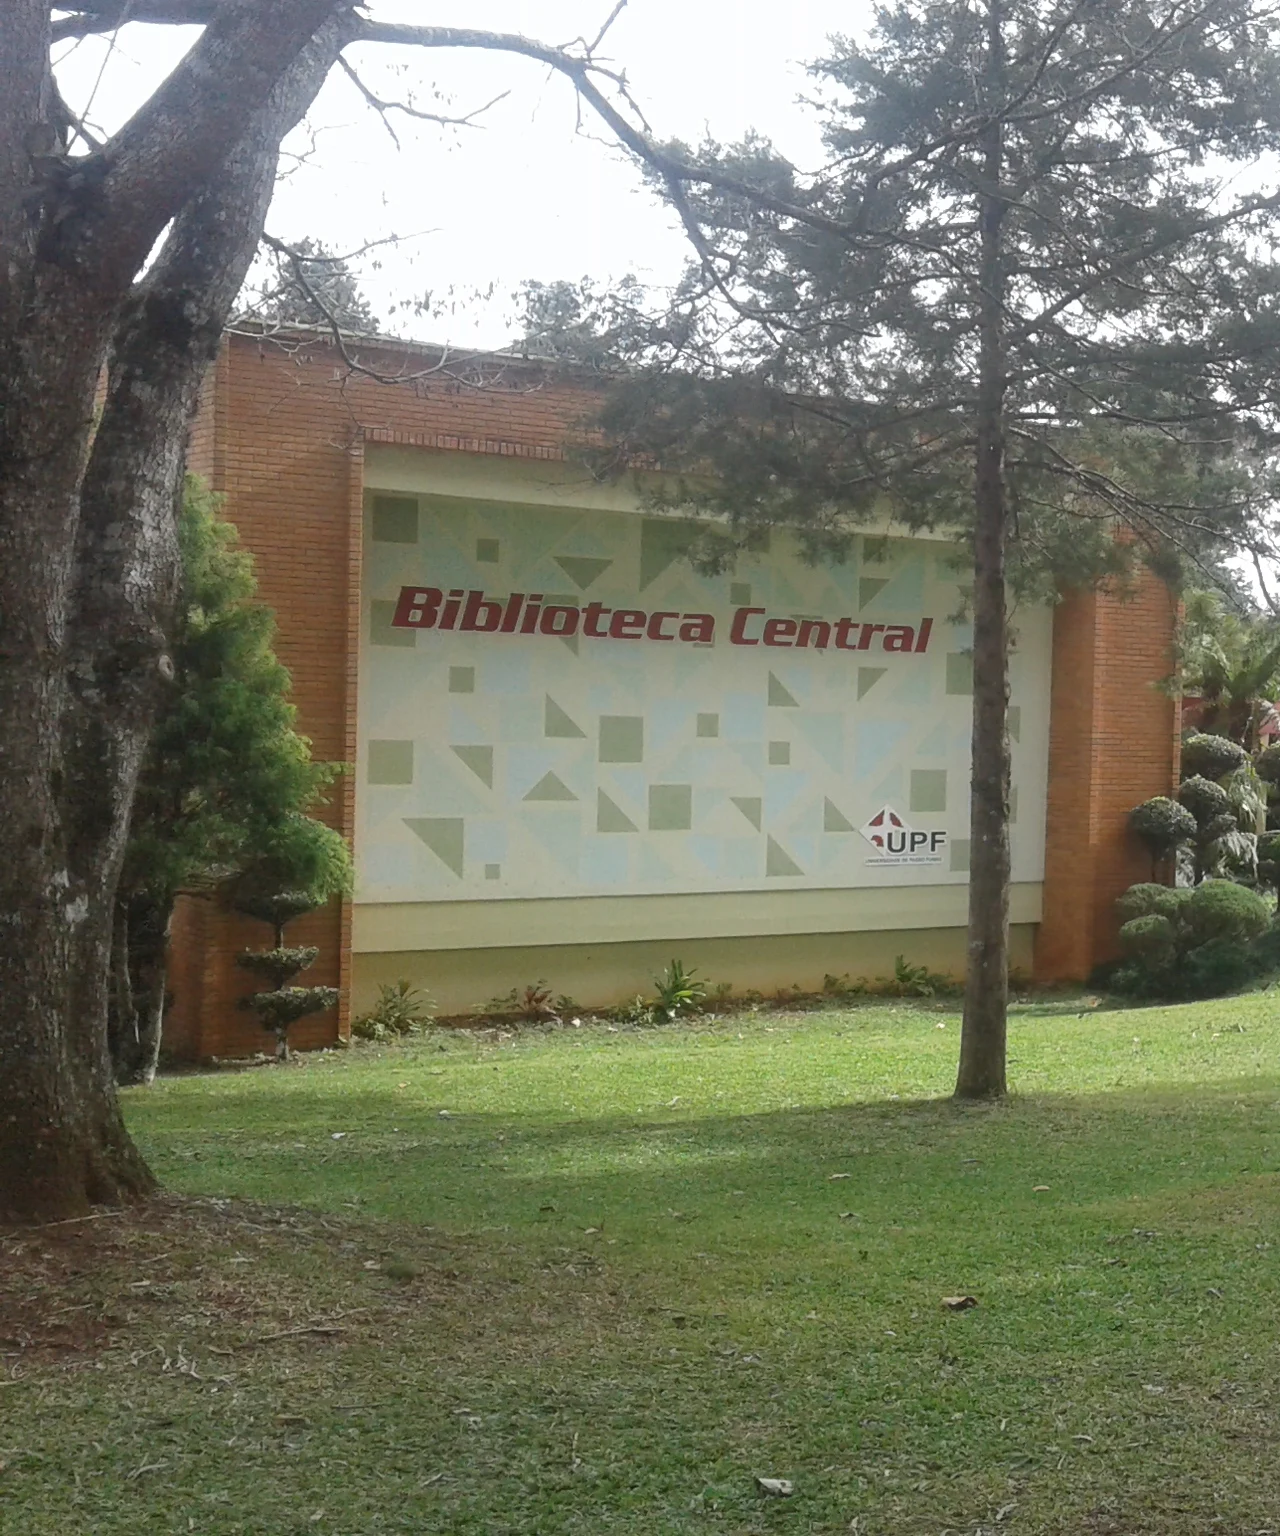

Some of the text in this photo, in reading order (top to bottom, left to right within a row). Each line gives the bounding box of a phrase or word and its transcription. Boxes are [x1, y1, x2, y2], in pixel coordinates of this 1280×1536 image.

[391, 585, 934, 653] Biblioteca Central
[887, 831, 947, 853] UPF
